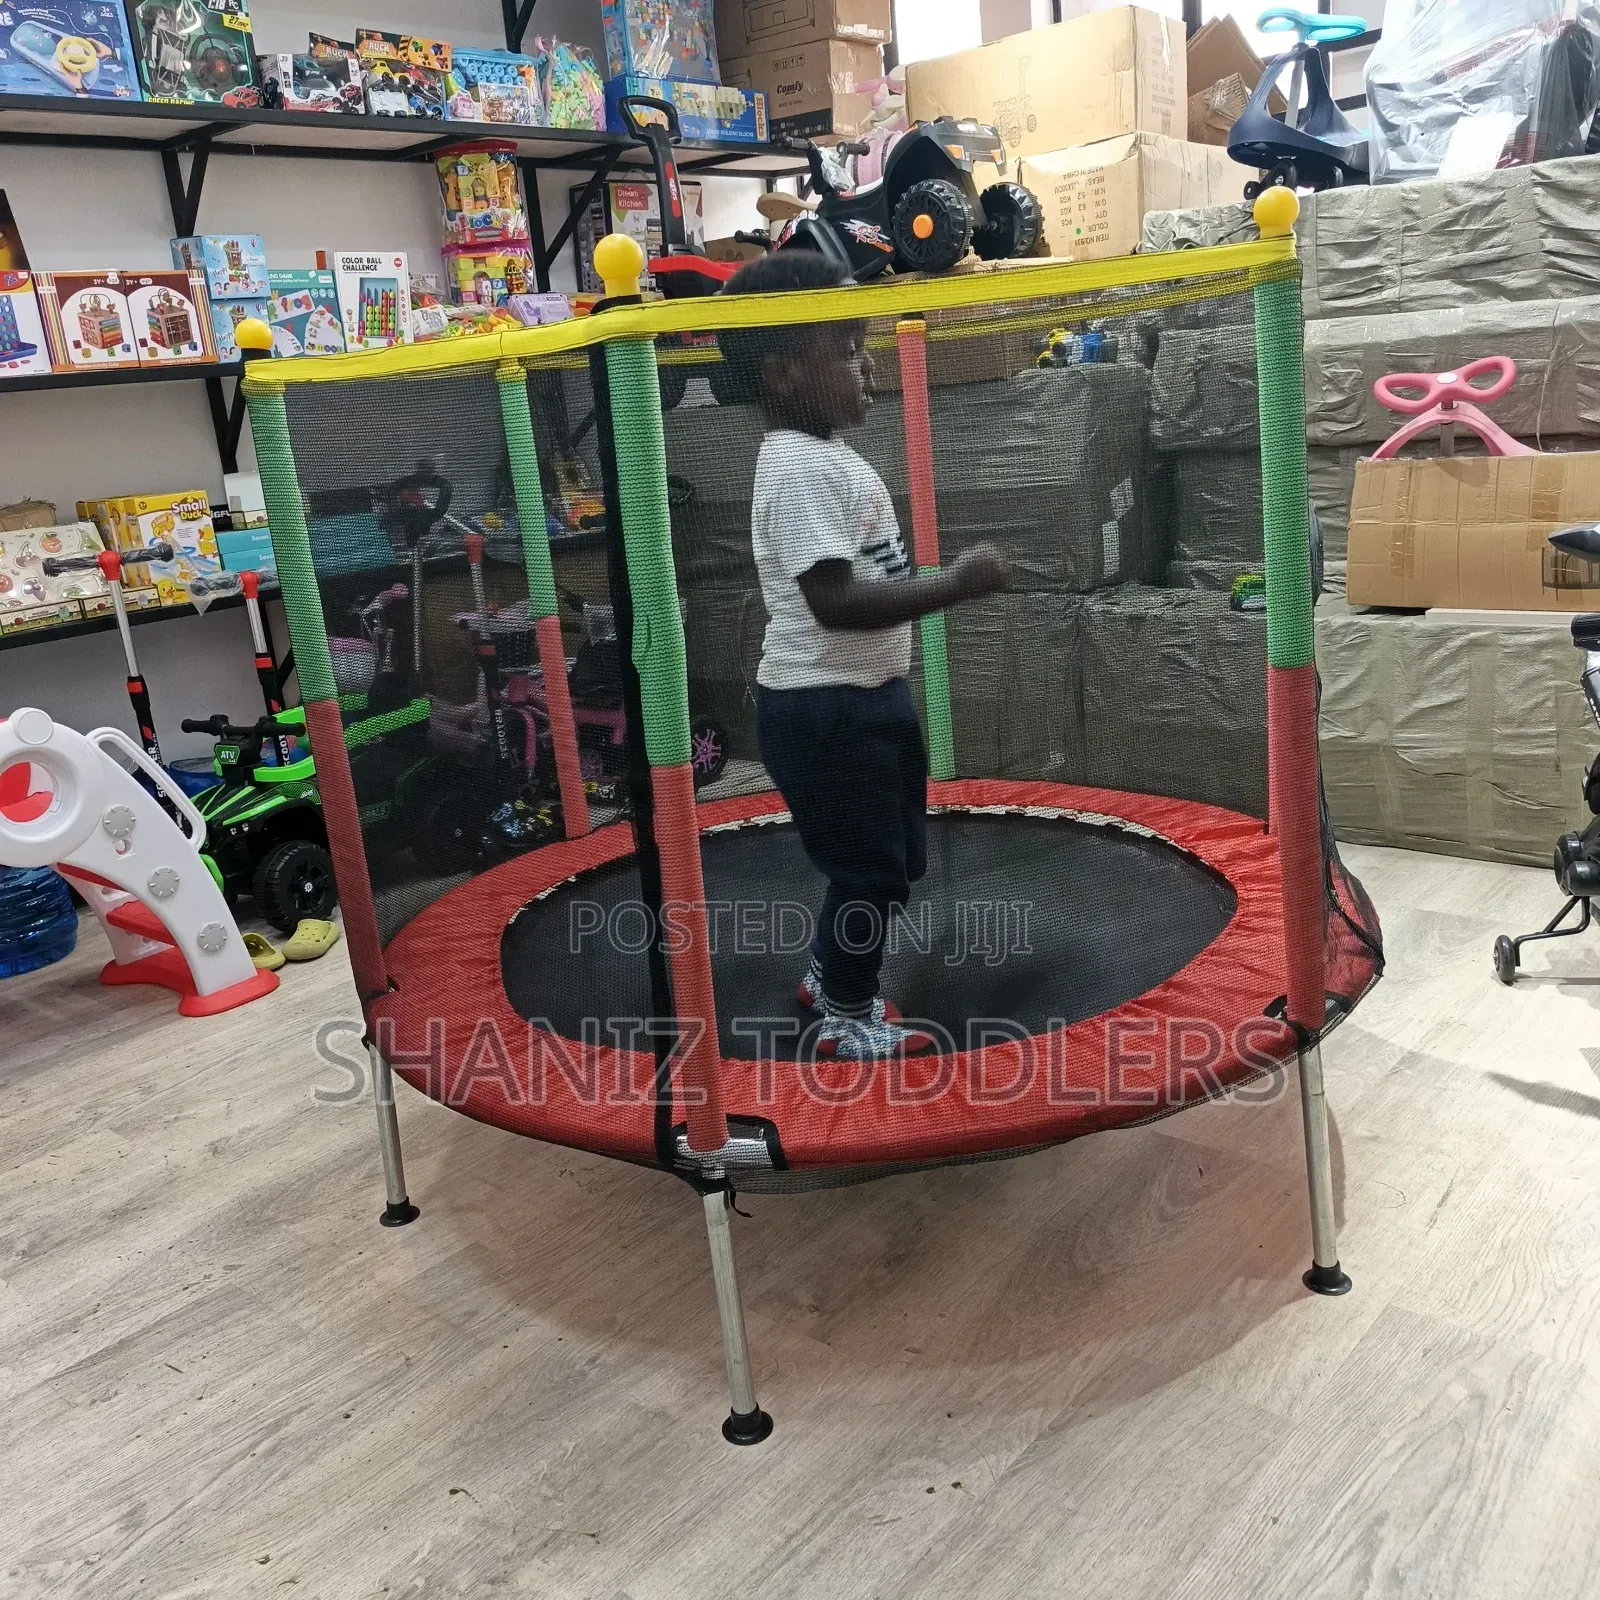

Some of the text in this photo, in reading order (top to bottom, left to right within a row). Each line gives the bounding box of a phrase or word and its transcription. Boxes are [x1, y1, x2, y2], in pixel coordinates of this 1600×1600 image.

[228, 15, 239, 25] 27
[776, 80, 804, 94] Comfy
[1063, 170, 1080, 180] CHINA
[617, 188, 639, 198] Dream
[618, 199, 643, 208] Kitchen
[1059, 195, 1071, 204] KGS
[1060, 206, 1072, 216] KGS
[1061, 218, 1073, 227] PCS
[1095, 233, 1110, 242] ITEM
[341, 257, 382, 265] COLOR BALL
[342, 264, 378, 272] CHALLENGE
[171, 499, 207, 513] Small
[180, 511, 203, 521] Duck
[220, 751, 235, 760] ATV
[278, 734, 292, 767] SCOOT
